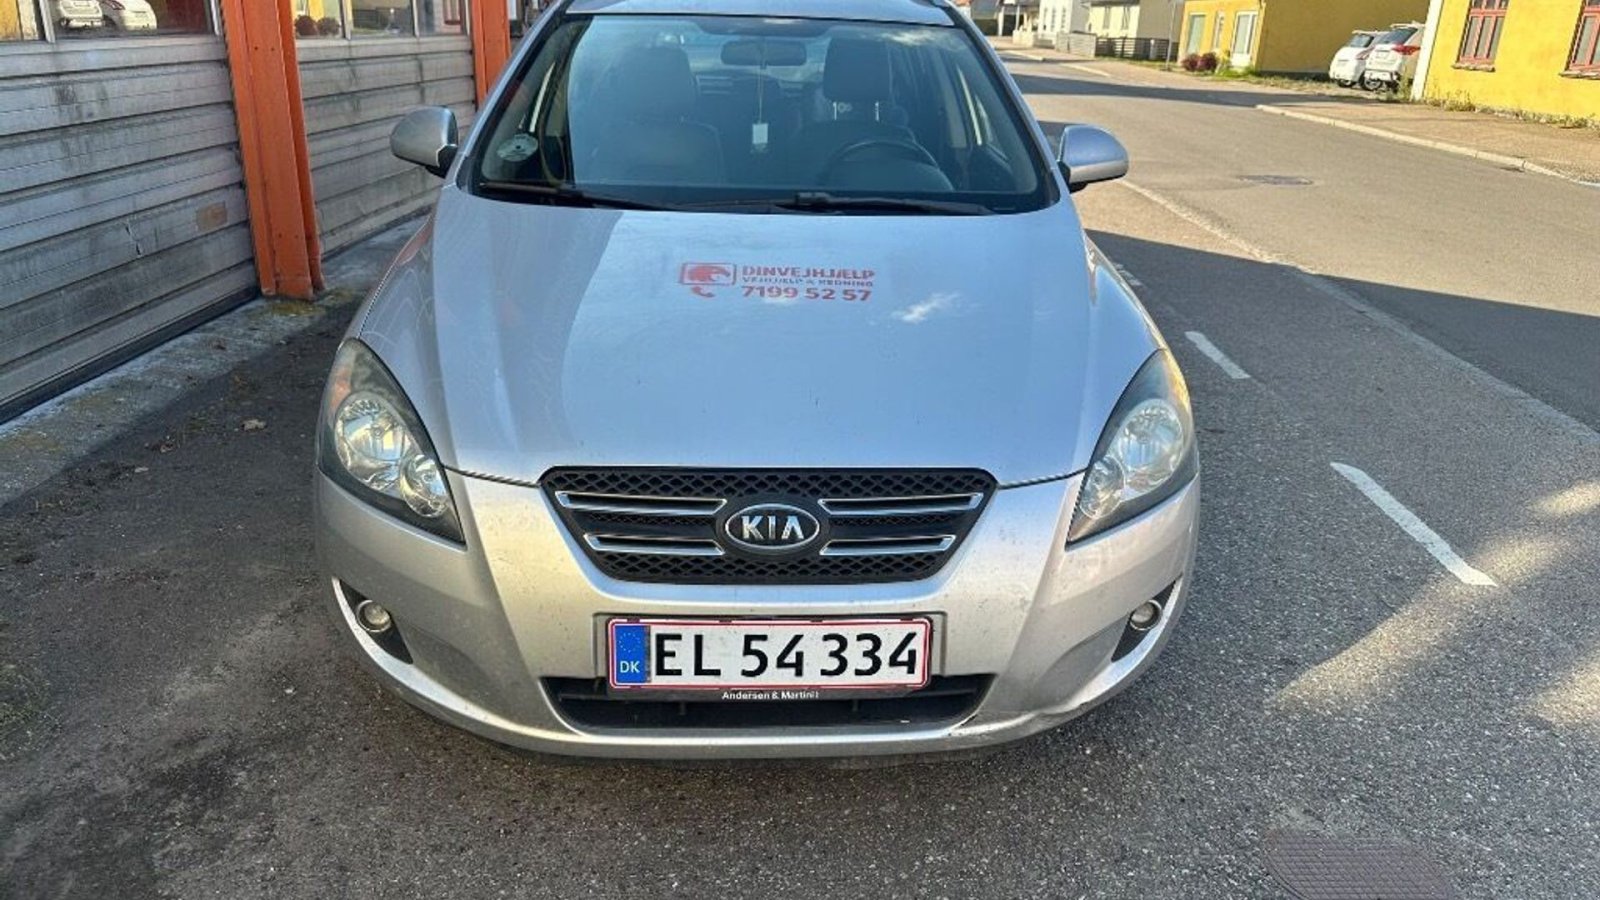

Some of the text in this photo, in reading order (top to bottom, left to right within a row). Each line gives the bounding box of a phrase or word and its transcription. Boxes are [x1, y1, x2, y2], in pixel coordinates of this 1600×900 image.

[742, 266, 875, 279] DINVEJHJÆLP
[741, 285, 872, 301] 7199 52 57
[741, 515, 804, 539] KIA
[655, 631, 918, 678] EL 54 334
[619, 660, 641, 674] DK
[722, 690, 770, 700] Andersen
[772, 691, 780, 700] &
